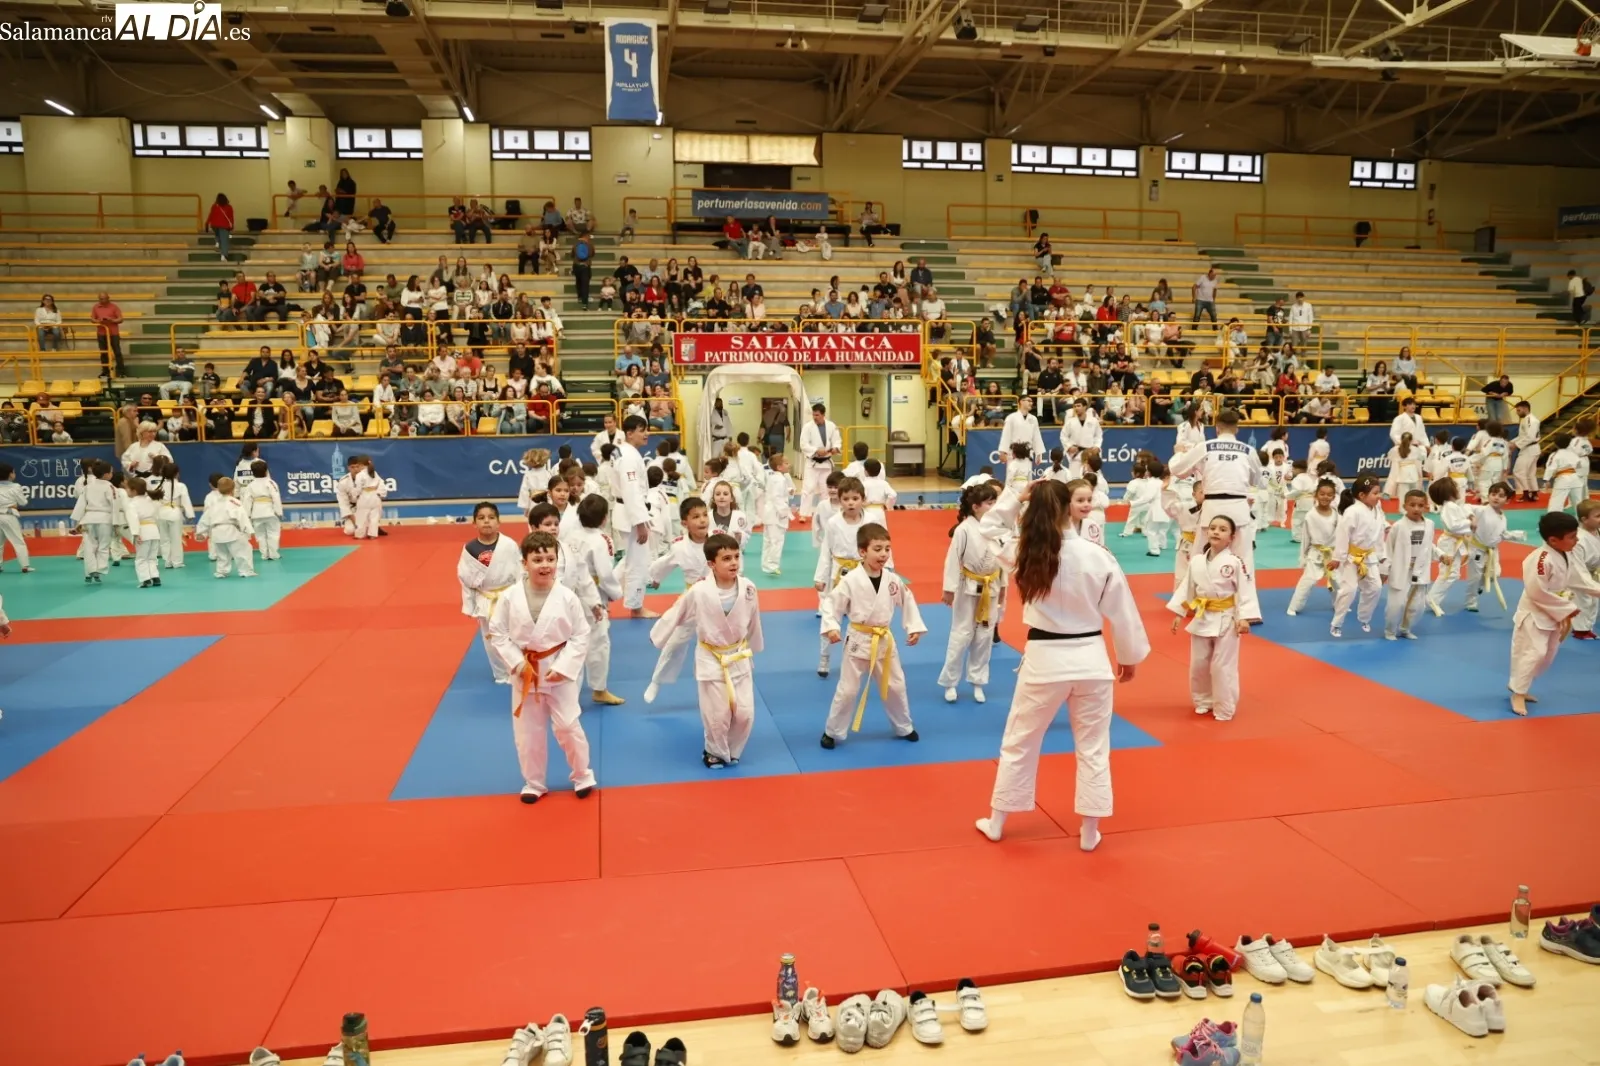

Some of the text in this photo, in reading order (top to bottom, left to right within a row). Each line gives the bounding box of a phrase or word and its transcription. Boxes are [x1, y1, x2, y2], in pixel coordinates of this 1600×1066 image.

[624, 48, 638, 78] 4
[697, 198, 822, 211] perfumeriasavenida.com
[730, 336, 894, 350] SALAMANCA
[704, 351, 914, 362] PATRIMONIO DE LA HUMANIDAD
[287, 470, 320, 480] turismo
